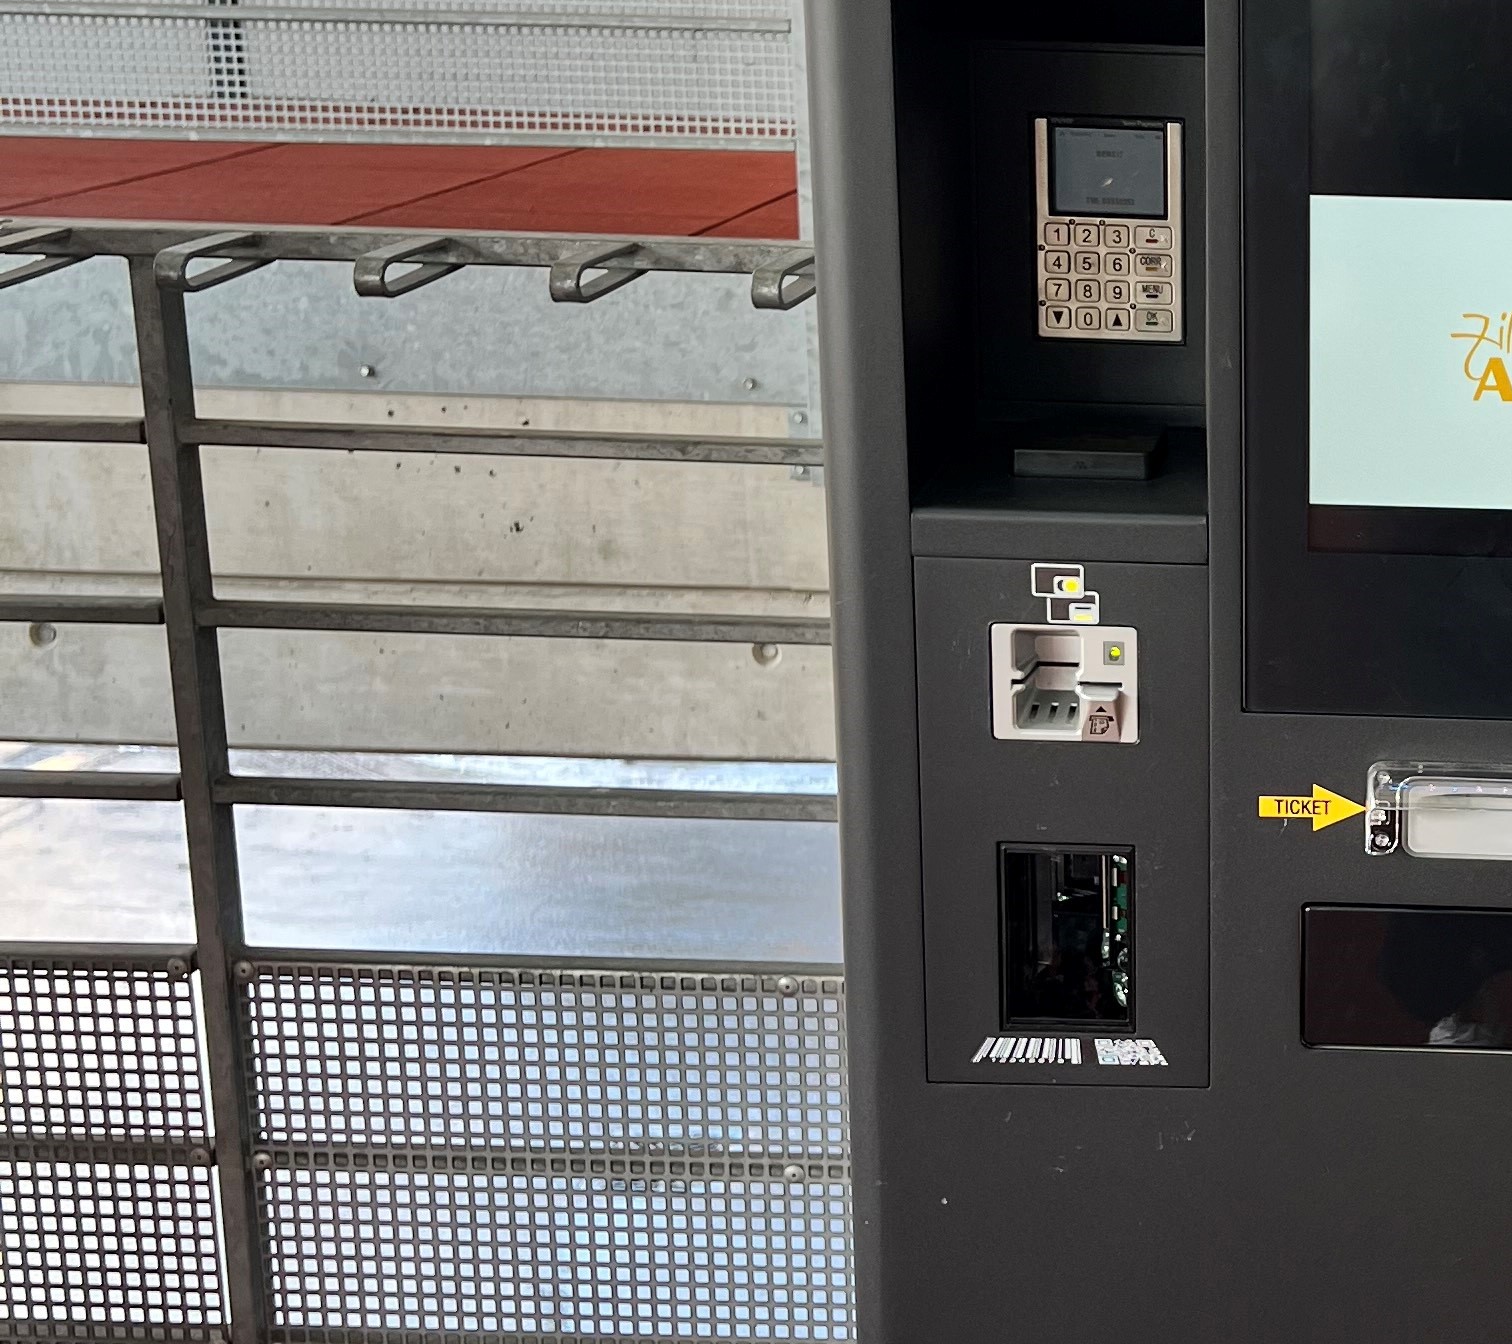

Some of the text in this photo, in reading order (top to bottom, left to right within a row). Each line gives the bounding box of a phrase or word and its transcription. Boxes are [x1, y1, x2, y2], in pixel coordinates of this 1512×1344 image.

[1053, 228, 1061, 241] 1
[1082, 228, 1092, 244] 2
[1112, 229, 1122, 244] 3
[1052, 255, 1063, 270] 4
[1082, 256, 1092, 271] 5
[1112, 257, 1123, 272] 6
[1052, 283, 1063, 298] 7
[1083, 284, 1093, 299] 8
[1112, 286, 1123, 300] 9
[1141, 284, 1163, 295] MENU
[1083, 312, 1093, 327] 0
[1274, 799, 1331, 815] TICKET
